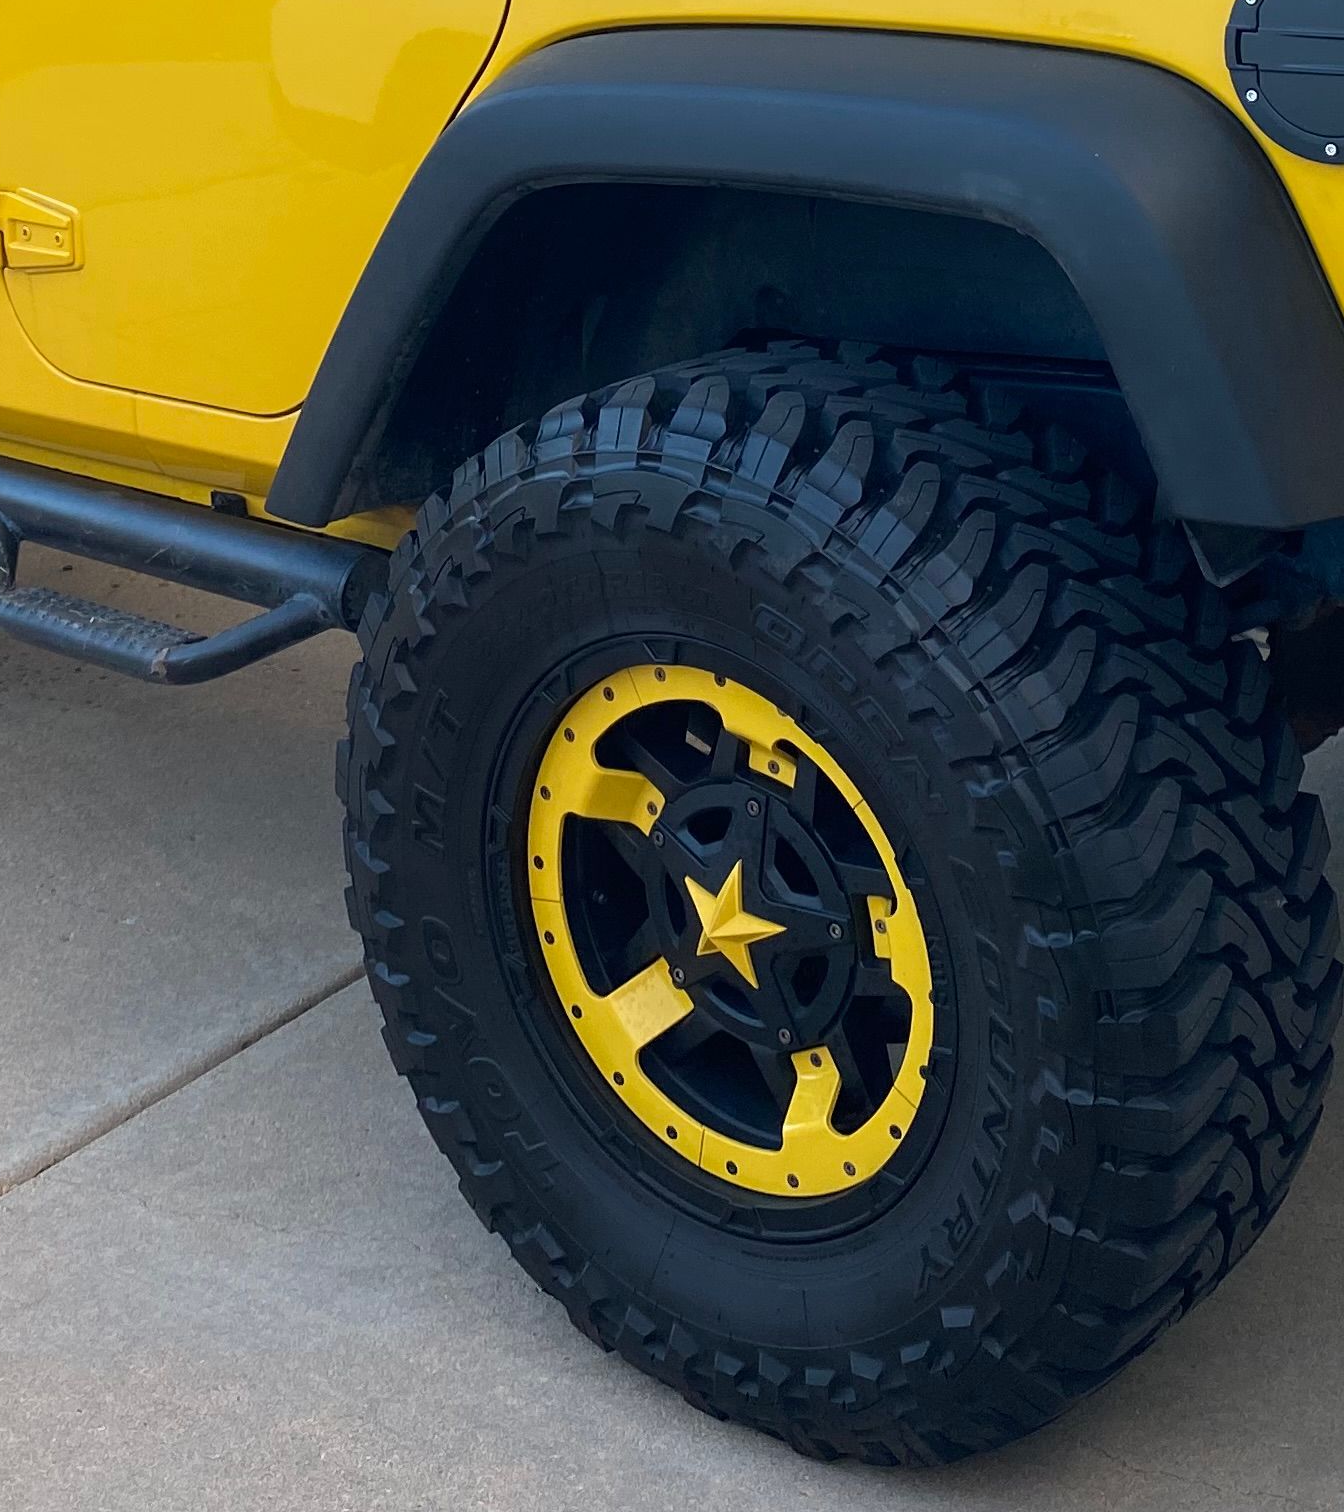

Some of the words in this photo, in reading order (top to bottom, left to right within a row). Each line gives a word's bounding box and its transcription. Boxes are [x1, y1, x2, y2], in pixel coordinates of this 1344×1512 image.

[411, 688, 462, 856] M/T
[421, 915, 561, 1192] TOYO
[914, 855, 1015, 1300] COUNTRY
